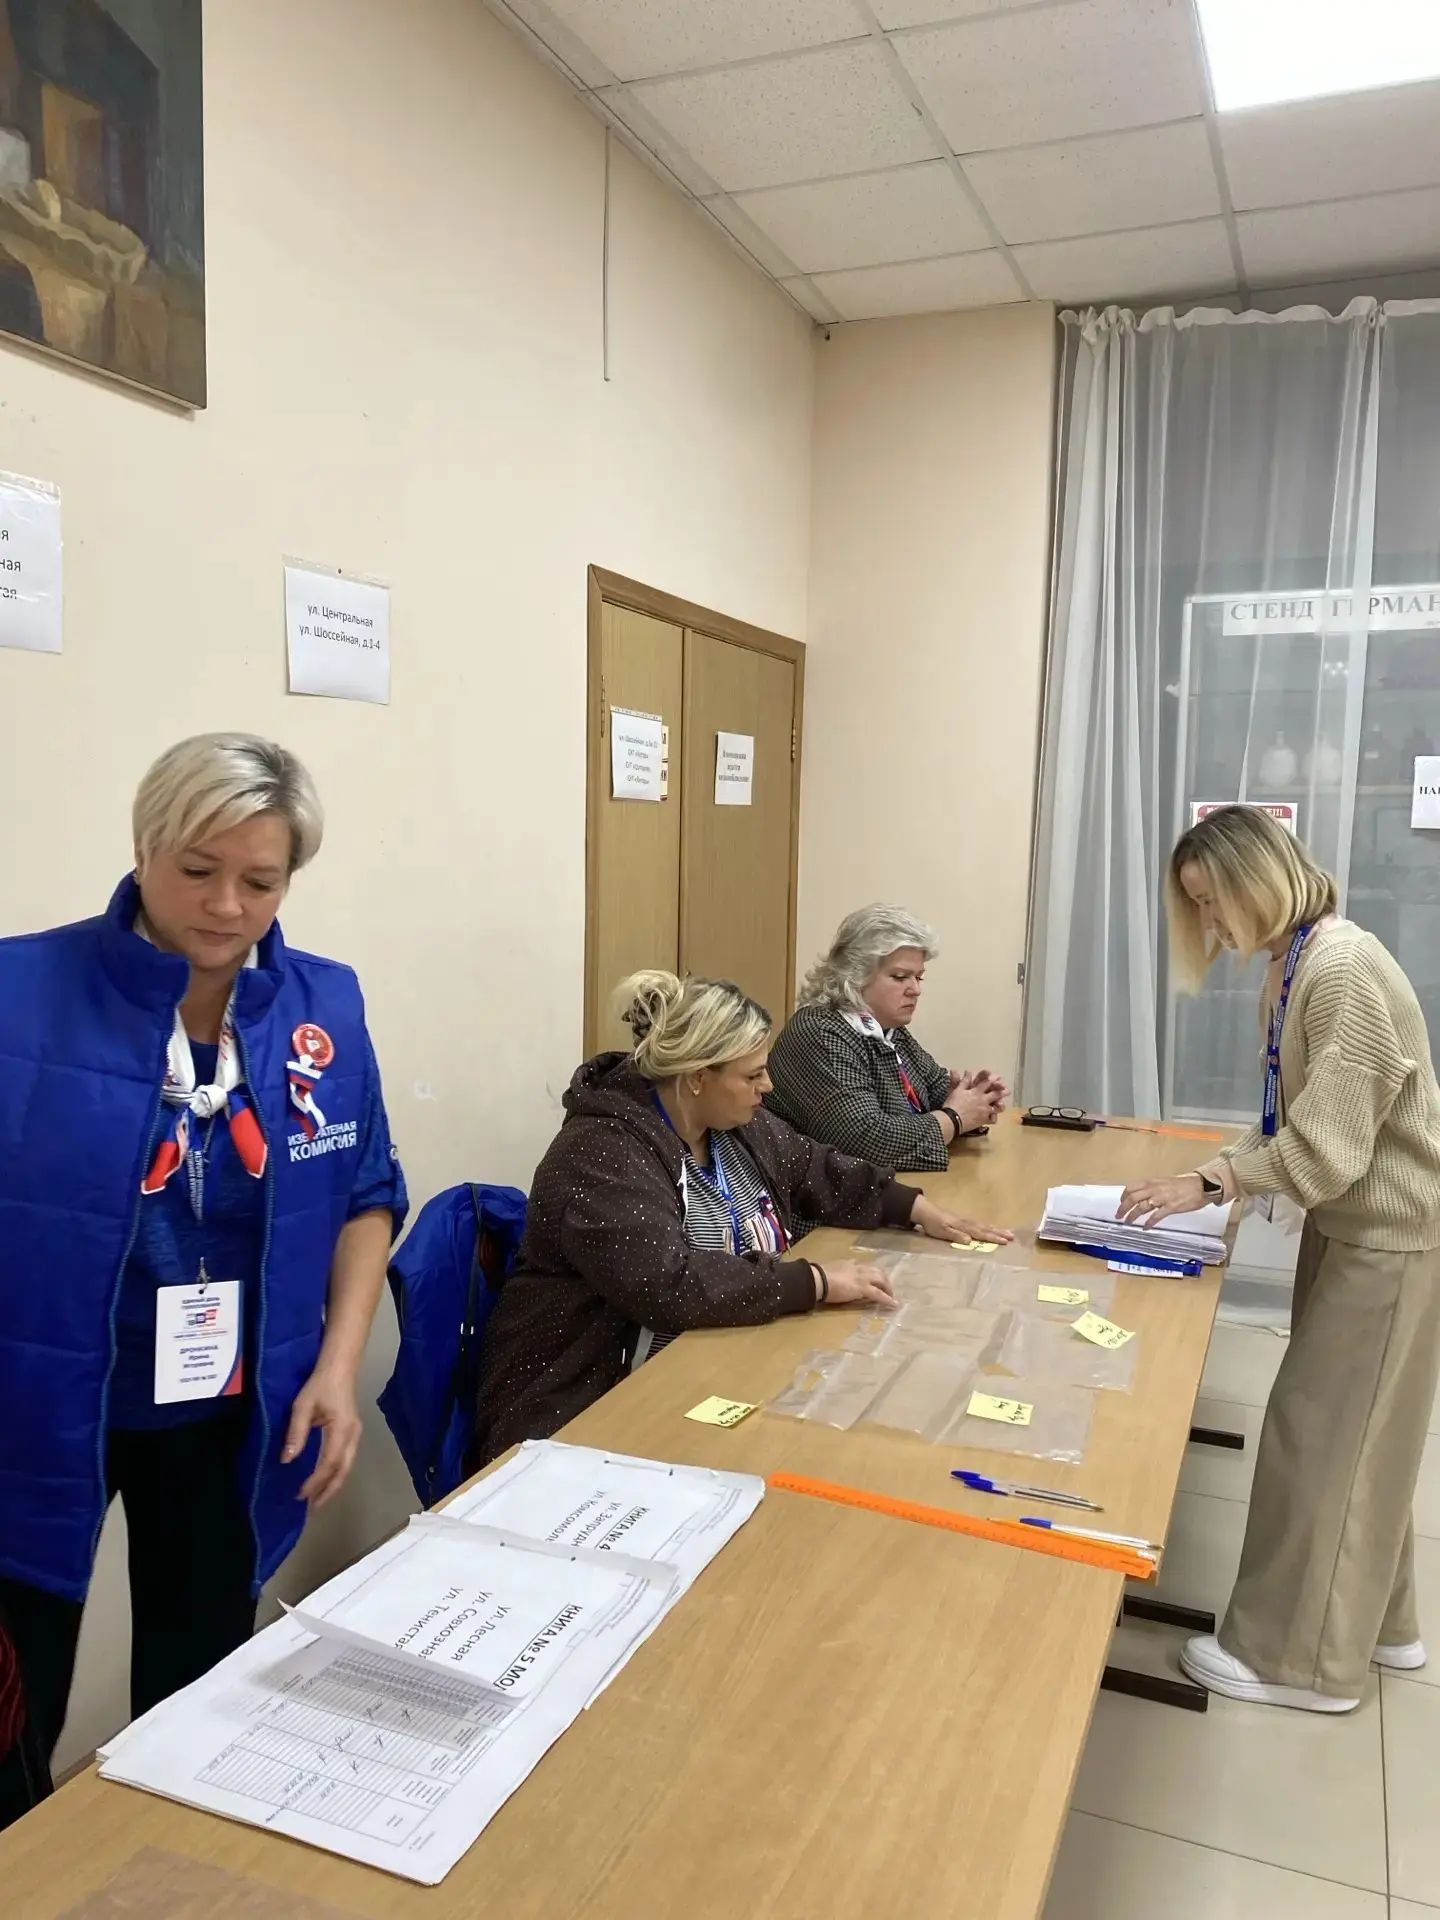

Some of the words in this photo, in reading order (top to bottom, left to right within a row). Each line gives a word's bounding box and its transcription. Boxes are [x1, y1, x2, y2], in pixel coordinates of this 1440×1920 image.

[307, 604, 320, 616] ул.
[322, 606, 374, 628] Центральная
[1230, 601, 1314, 621] СТЕНД
[1332, 594, 1440, 617] ГРМАН
[299, 624, 312, 637] ул.
[313, 625, 361, 648] Шоссейная,
[571, 1512, 613, 1547] Запрудн
[615, 1506, 650, 1530] КНИГА
[605, 1530, 623, 1542] №
[442, 1586, 464, 1600] ул.
[472, 1591, 493, 1605] ул.
[490, 1605, 511, 1620] ул.
[542, 1604, 583, 1636] КНИГА
[450, 1620, 496, 1661] Лесная
[528, 1638, 550, 1652] №
[520, 1654, 535, 1663] 5
